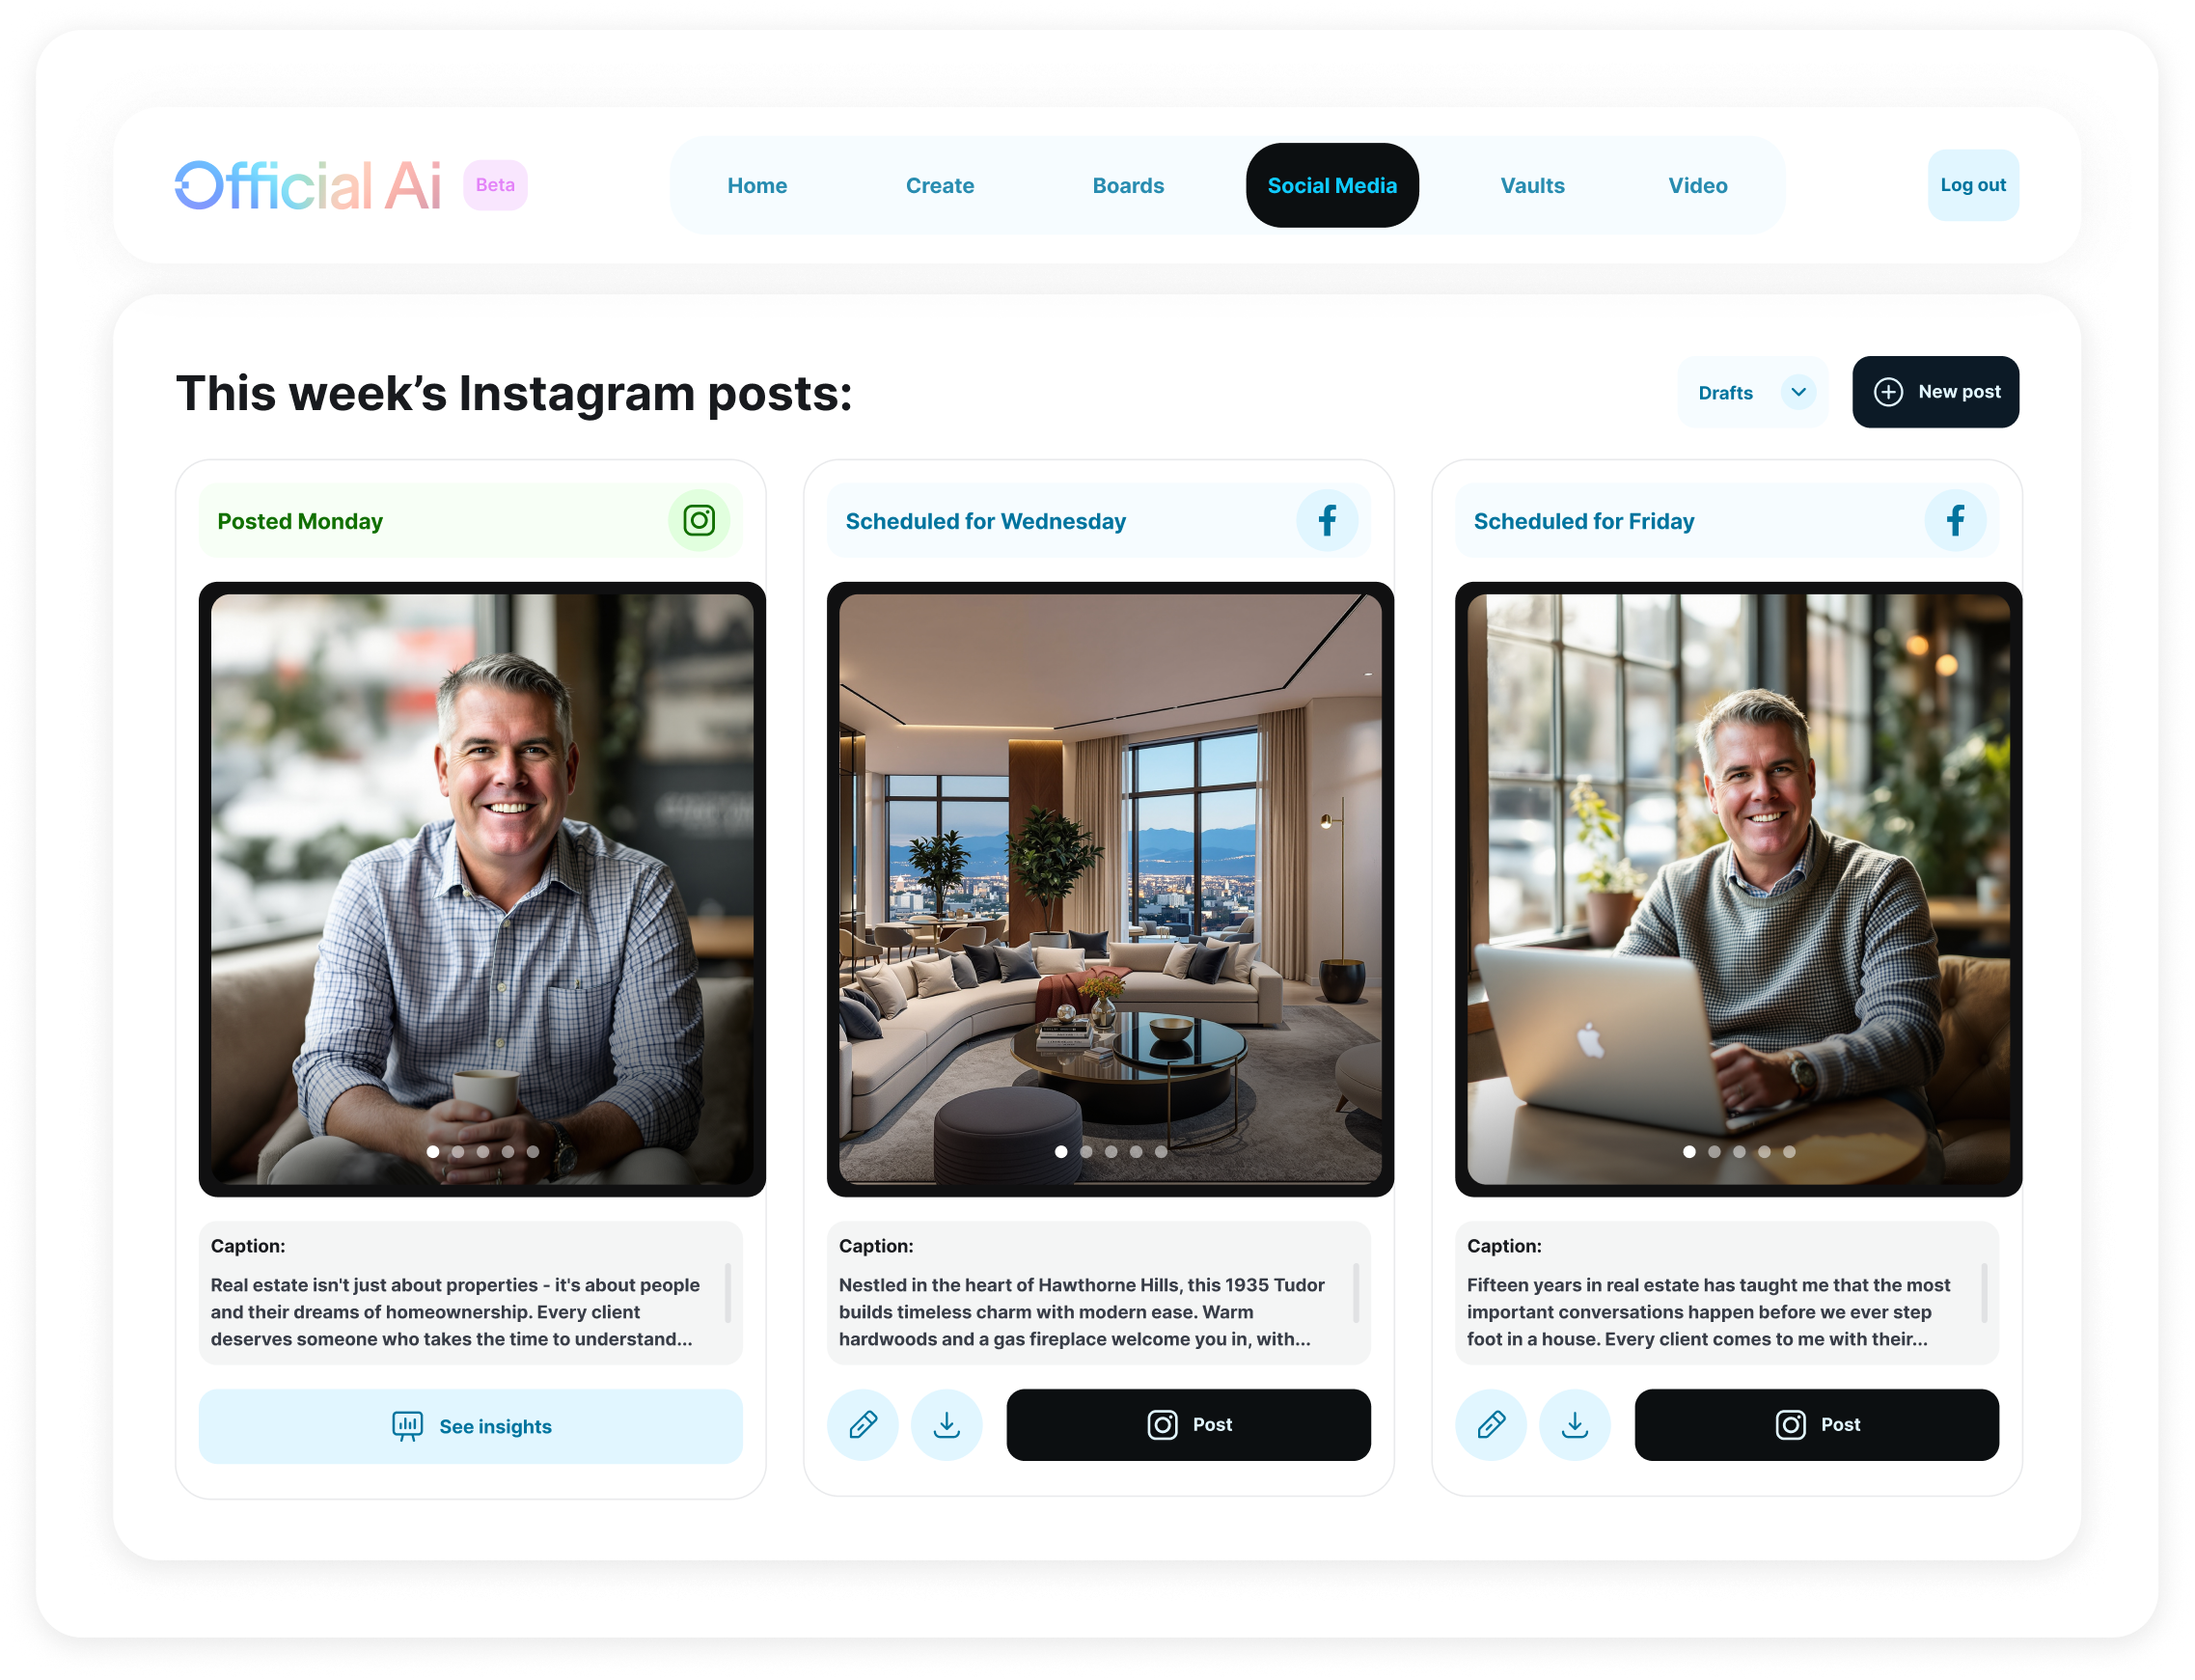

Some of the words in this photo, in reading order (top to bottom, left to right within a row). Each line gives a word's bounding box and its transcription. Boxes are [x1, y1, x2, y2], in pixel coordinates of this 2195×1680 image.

[174, 159, 371, 210] Official
[384, 160, 441, 209] Ai
[476, 177, 515, 192] Beta
[727, 177, 788, 195] Home
[906, 177, 975, 195] Create
[1093, 177, 1166, 195] Boards
[1268, 176, 1331, 195] Social
[1335, 176, 1398, 195] Media
[1500, 177, 1566, 195] Vaults
[1668, 176, 1729, 195] Video
[1941, 177, 1974, 196] Log
[1977, 178, 2008, 192] out
[176, 372, 276, 412] This
[288, 374, 448, 412] week’s
[460, 374, 695, 422] Instagram
[709, 376, 852, 421] posts:
[1699, 384, 1754, 400] Drafts
[1919, 383, 1959, 399] New
[1962, 384, 2002, 402] post
[218, 511, 292, 531] Posted
[298, 511, 384, 535] Monday
[845, 511, 960, 531] Scheduled
[964, 511, 997, 531] for
[1000, 511, 1128, 535] Wednesday
[1473, 511, 1588, 531] Scheduled
[1592, 511, 1625, 531] for
[1629, 510, 1696, 535] Friday
[210, 1237, 286, 1257] Caption:
[838, 1237, 914, 1257] Caption:
[1467, 1237, 1542, 1257] Caption:
[210, 1277, 249, 1293] Real
[252, 1278, 309, 1293] estate
[313, 1277, 350, 1293] isn't
[352, 1277, 388, 1296] just
[391, 1277, 443, 1293] about
[446, 1277, 538, 1296] properties
[555, 1277, 582, 1293] it's
[585, 1277, 637, 1293] about
[640, 1277, 700, 1296] people
[838, 1277, 908, 1293] Nestled
[912, 1277, 928, 1293] in
[931, 1277, 962, 1293] the
[965, 1277, 1013, 1293] heart
[1016, 1277, 1035, 1293] of
[1038, 1277, 1137, 1293] Hawthorne
[1140, 1277, 1184, 1296] Hills,
[1187, 1277, 1221, 1293] this
[1225, 1277, 1270, 1293] 1935
[1273, 1277, 1326, 1293] Tudor
[1468, 1277, 1529, 1293] Fifteen
[1532, 1281, 1582, 1296] years
[1586, 1277, 1603, 1293] in
[1606, 1277, 1639, 1293] real
[1643, 1278, 1700, 1293] estate
[1704, 1277, 1736, 1293] has
[1739, 1277, 1798, 1297] taught
[1801, 1281, 1829, 1293] me
[1832, 1277, 1870, 1293] that
[1873, 1277, 1903, 1293] the
[1907, 1278, 1952, 1293] most
[210, 1304, 244, 1320] and
[247, 1304, 290, 1320] their
[293, 1304, 360, 1320] dreams
[363, 1304, 383, 1320] of
[386, 1304, 534, 1323] homeownership.
[536, 1304, 588, 1323] Every
[590, 1304, 642, 1320] client
[838, 1304, 893, 1320] builds
[896, 1304, 973, 1320] timeless
[975, 1304, 1032, 1320] charm
[1035, 1304, 1075, 1320] with
[1079, 1304, 1147, 1320] modern
[1151, 1308, 1198, 1320] ease.
[1201, 1304, 1254, 1320] Warm
[1468, 1304, 1555, 1323] important
[1558, 1304, 1685, 1320] conversations
[1687, 1304, 1755, 1323] happen
[1759, 1304, 1817, 1320] before
[1820, 1308, 1847, 1320] we
[1850, 1308, 1890, 1320] ever
[1893, 1305, 1933, 1323] step
[210, 1331, 293, 1347] deserves
[296, 1335, 378, 1347] someone
[381, 1331, 420, 1347] who
[423, 1331, 473, 1347] takes
[476, 1331, 506, 1347] the
[508, 1331, 549, 1347] time
[552, 1332, 571, 1347] to
[574, 1331, 693, 1347] understand...
[838, 1331, 938, 1347] hardwoods
[941, 1331, 974, 1347] and
[978, 1335, 990, 1347] a
[993, 1335, 1026, 1351] gas
[1029, 1331, 1108, 1350] fireplace
[1111, 1331, 1192, 1347] welcome
[1194, 1335, 1227, 1350] you
[1231, 1331, 1252, 1350] in,
[1255, 1331, 1311, 1347] with...
[1467, 1331, 1503, 1347] foot
[1507, 1331, 1523, 1347] in
[1526, 1335, 1538, 1347] a
[1542, 1331, 1602, 1347] house.
[1605, 1331, 1656, 1350] Every
[1659, 1331, 1709, 1347] client
[1713, 1335, 1772, 1347] comes
[1775, 1332, 1795, 1347] to
[1797, 1335, 1825, 1347] me
[1828, 1331, 1868, 1347] with
[1871, 1331, 1928, 1347] their...
[439, 1418, 475, 1435] See
[479, 1418, 553, 1439] insights
[1194, 1417, 1233, 1432] Post
[1822, 1417, 1861, 1432] Post
